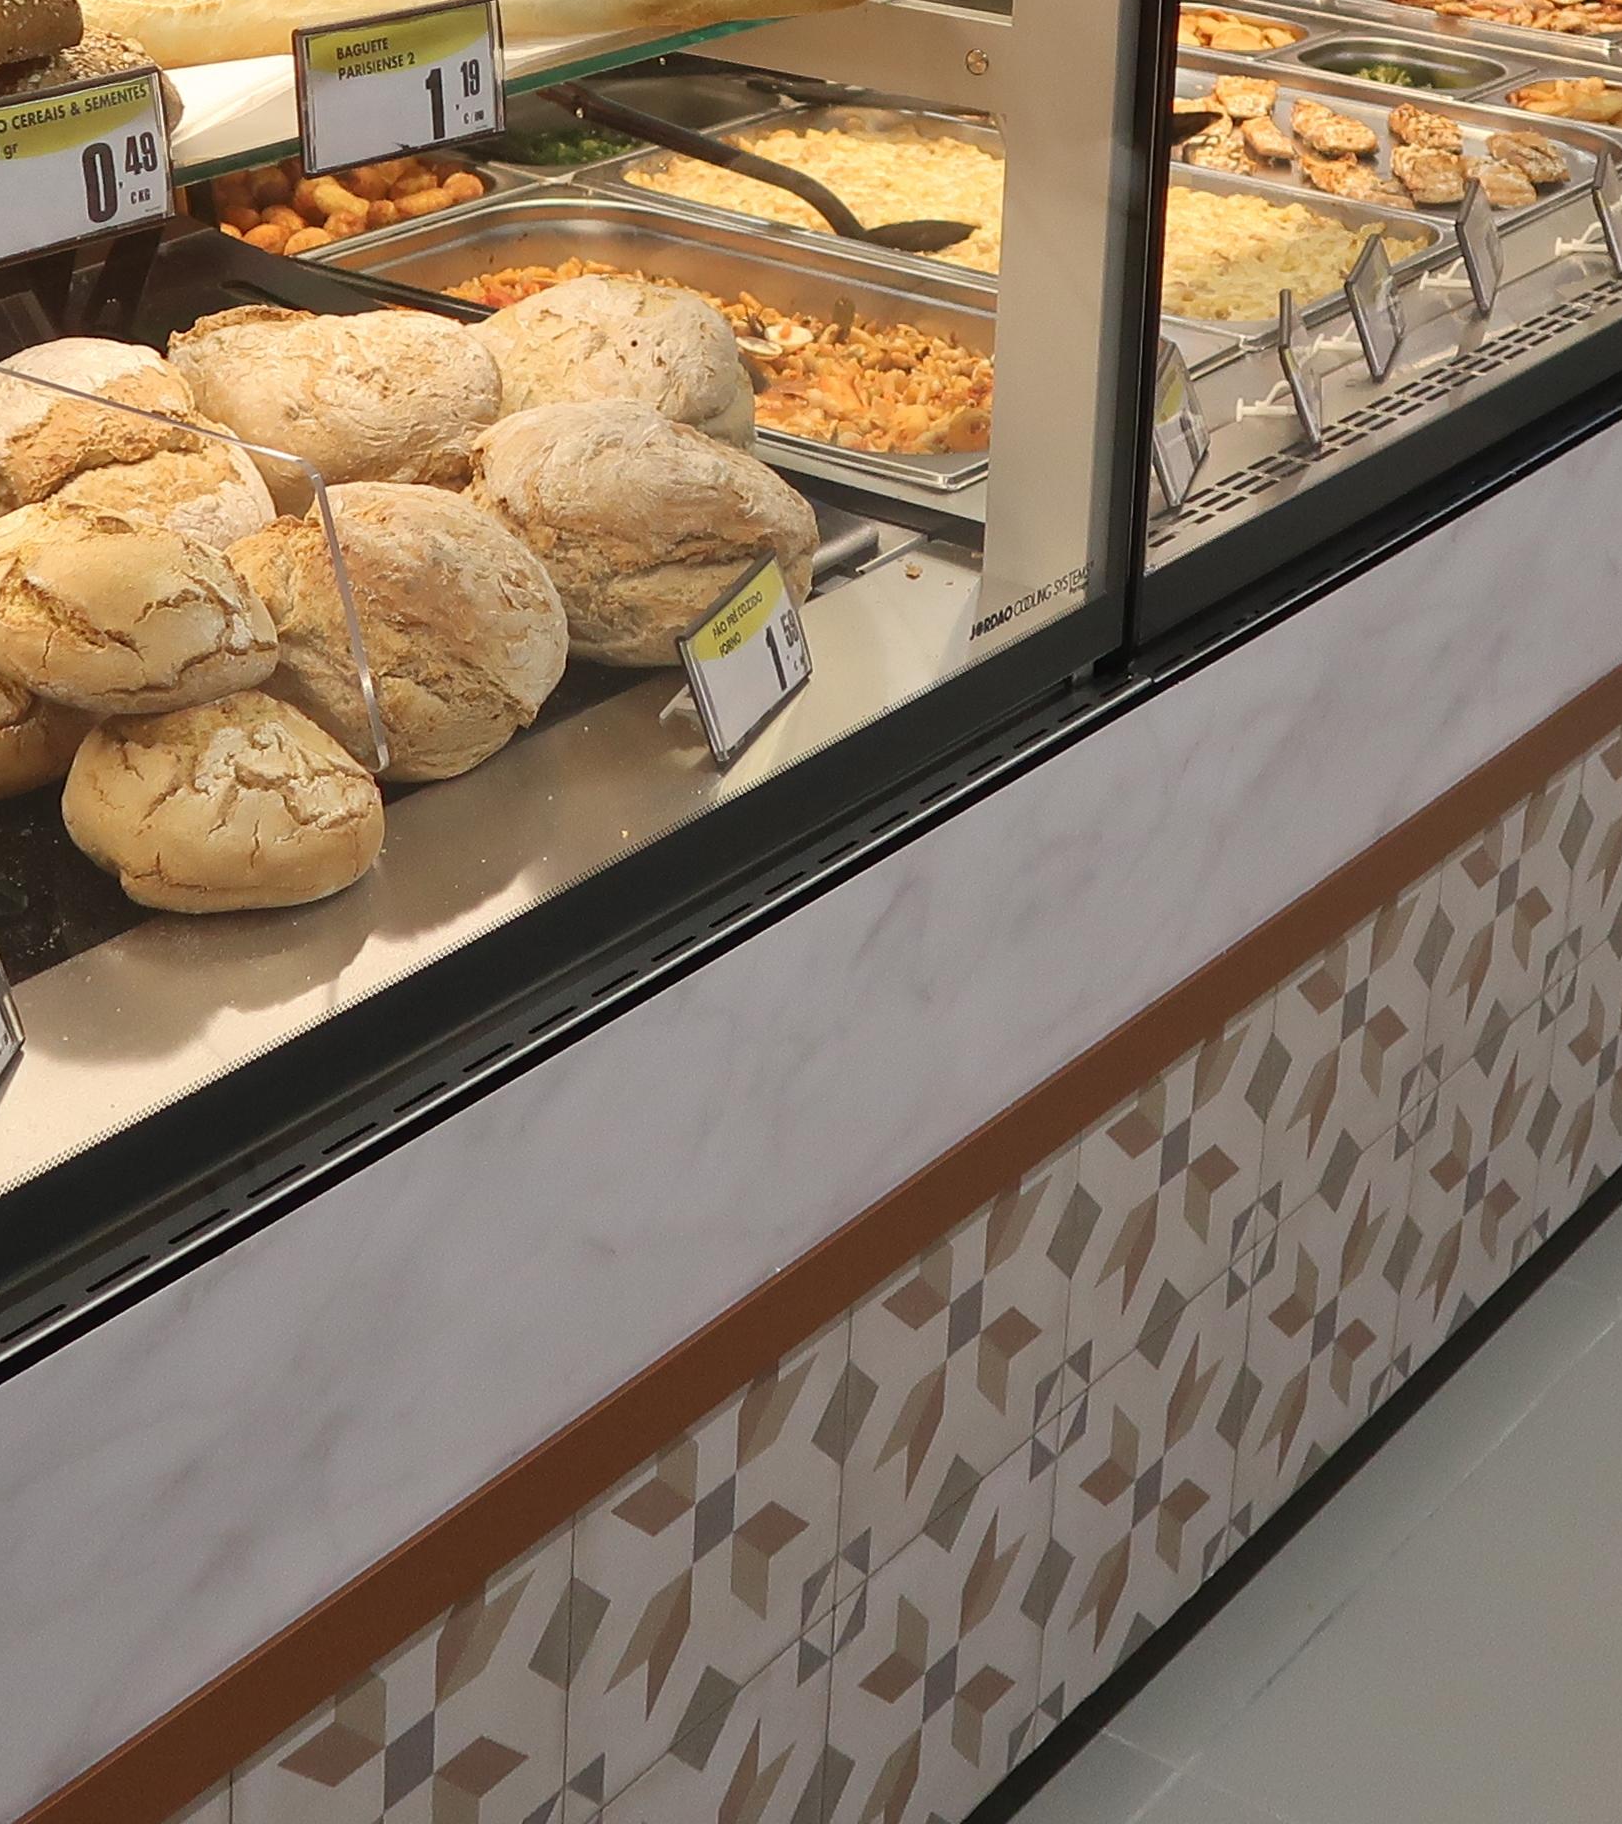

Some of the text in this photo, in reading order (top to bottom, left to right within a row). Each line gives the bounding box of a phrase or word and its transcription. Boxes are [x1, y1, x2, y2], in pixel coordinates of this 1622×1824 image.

[336, 37, 389, 61] BAGUETE
[338, 51, 416, 81] PARISIENSE 2
[11, 104, 66, 131] CEREAIS
[69, 101, 82, 116] &
[84, 82, 148, 113] SEMENTES
[3, 141, 19, 160] gr
[1013, 583, 1053, 618] COOLING
